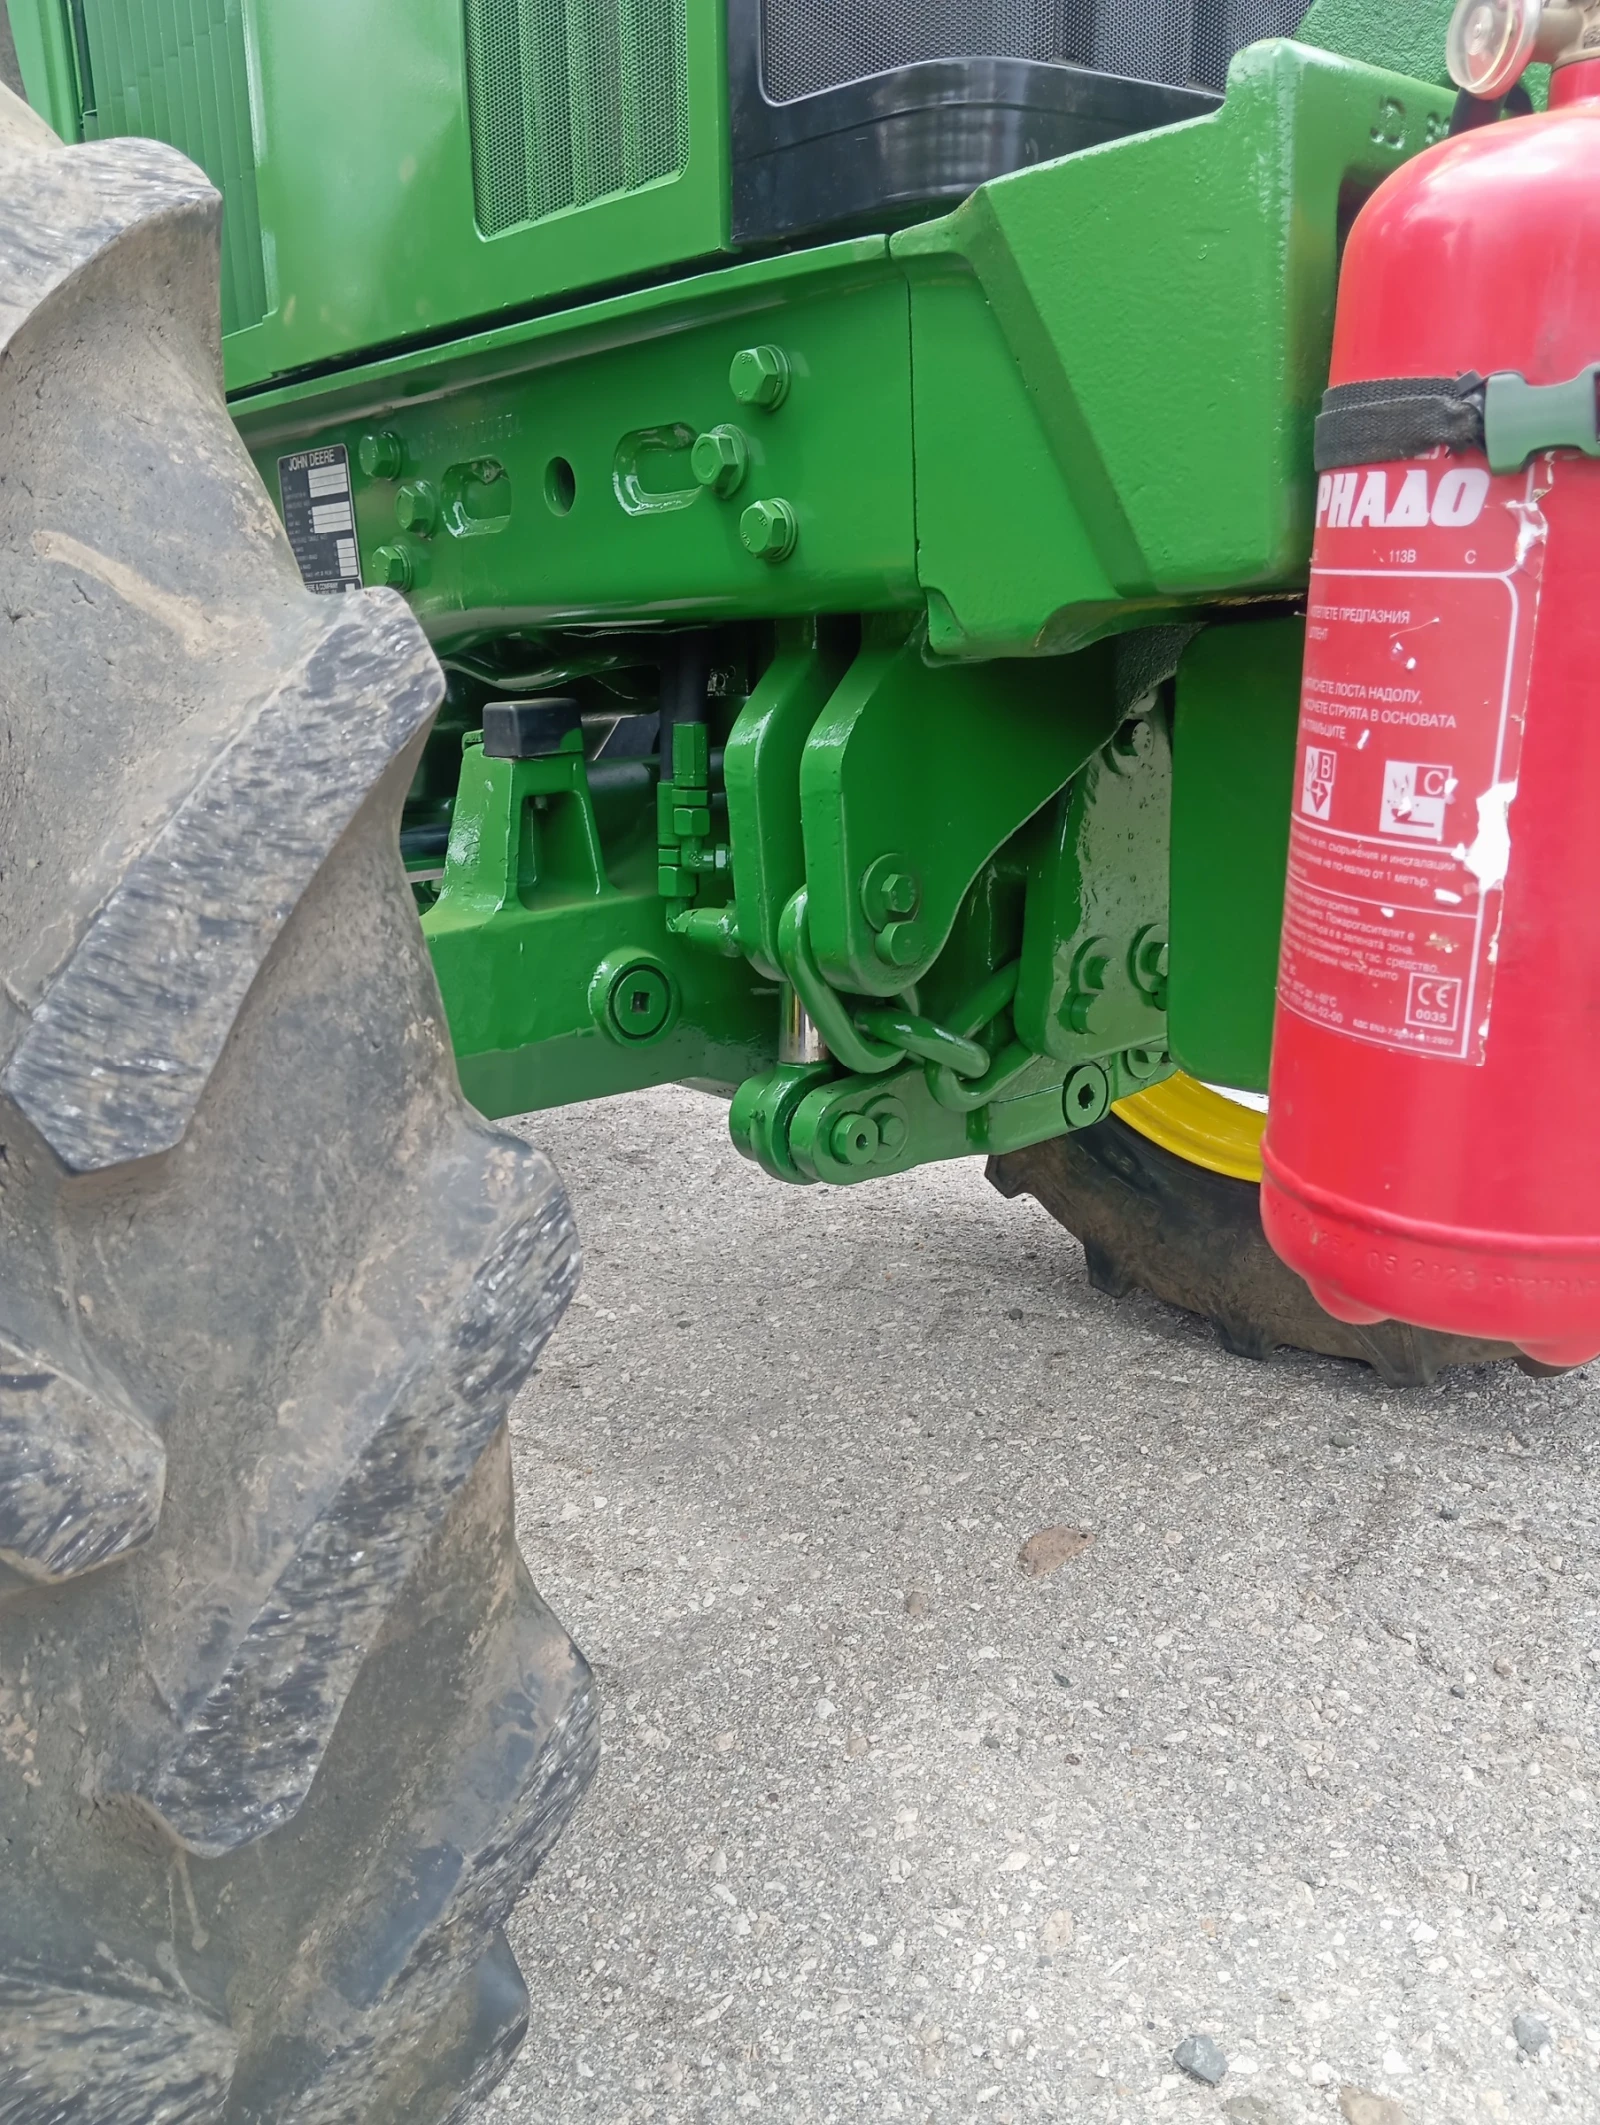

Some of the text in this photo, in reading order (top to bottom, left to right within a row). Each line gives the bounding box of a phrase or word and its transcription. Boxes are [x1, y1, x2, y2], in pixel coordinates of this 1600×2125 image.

[288, 449, 335, 472] JOHN DEERE
[1389, 550, 1416, 563] 113B
[1339, 607, 1411, 624] ПРЕДПАЗНИЯ
[1335, 682, 1367, 699] ЛОСТА
[1328, 704, 1369, 721] СТРУЯТА
[1370, 708, 1378, 722] В
[1381, 710, 1457, 729] ОСНОВАТА
[1321, 755, 1331, 779] B
[1423, 770, 1445, 796] C
[1389, 855, 1457, 873] инсталации
[1372, 870, 1384, 880] от
[1394, 873, 1430, 889] метър.
[1415, 1008, 1448, 1024] 0035
